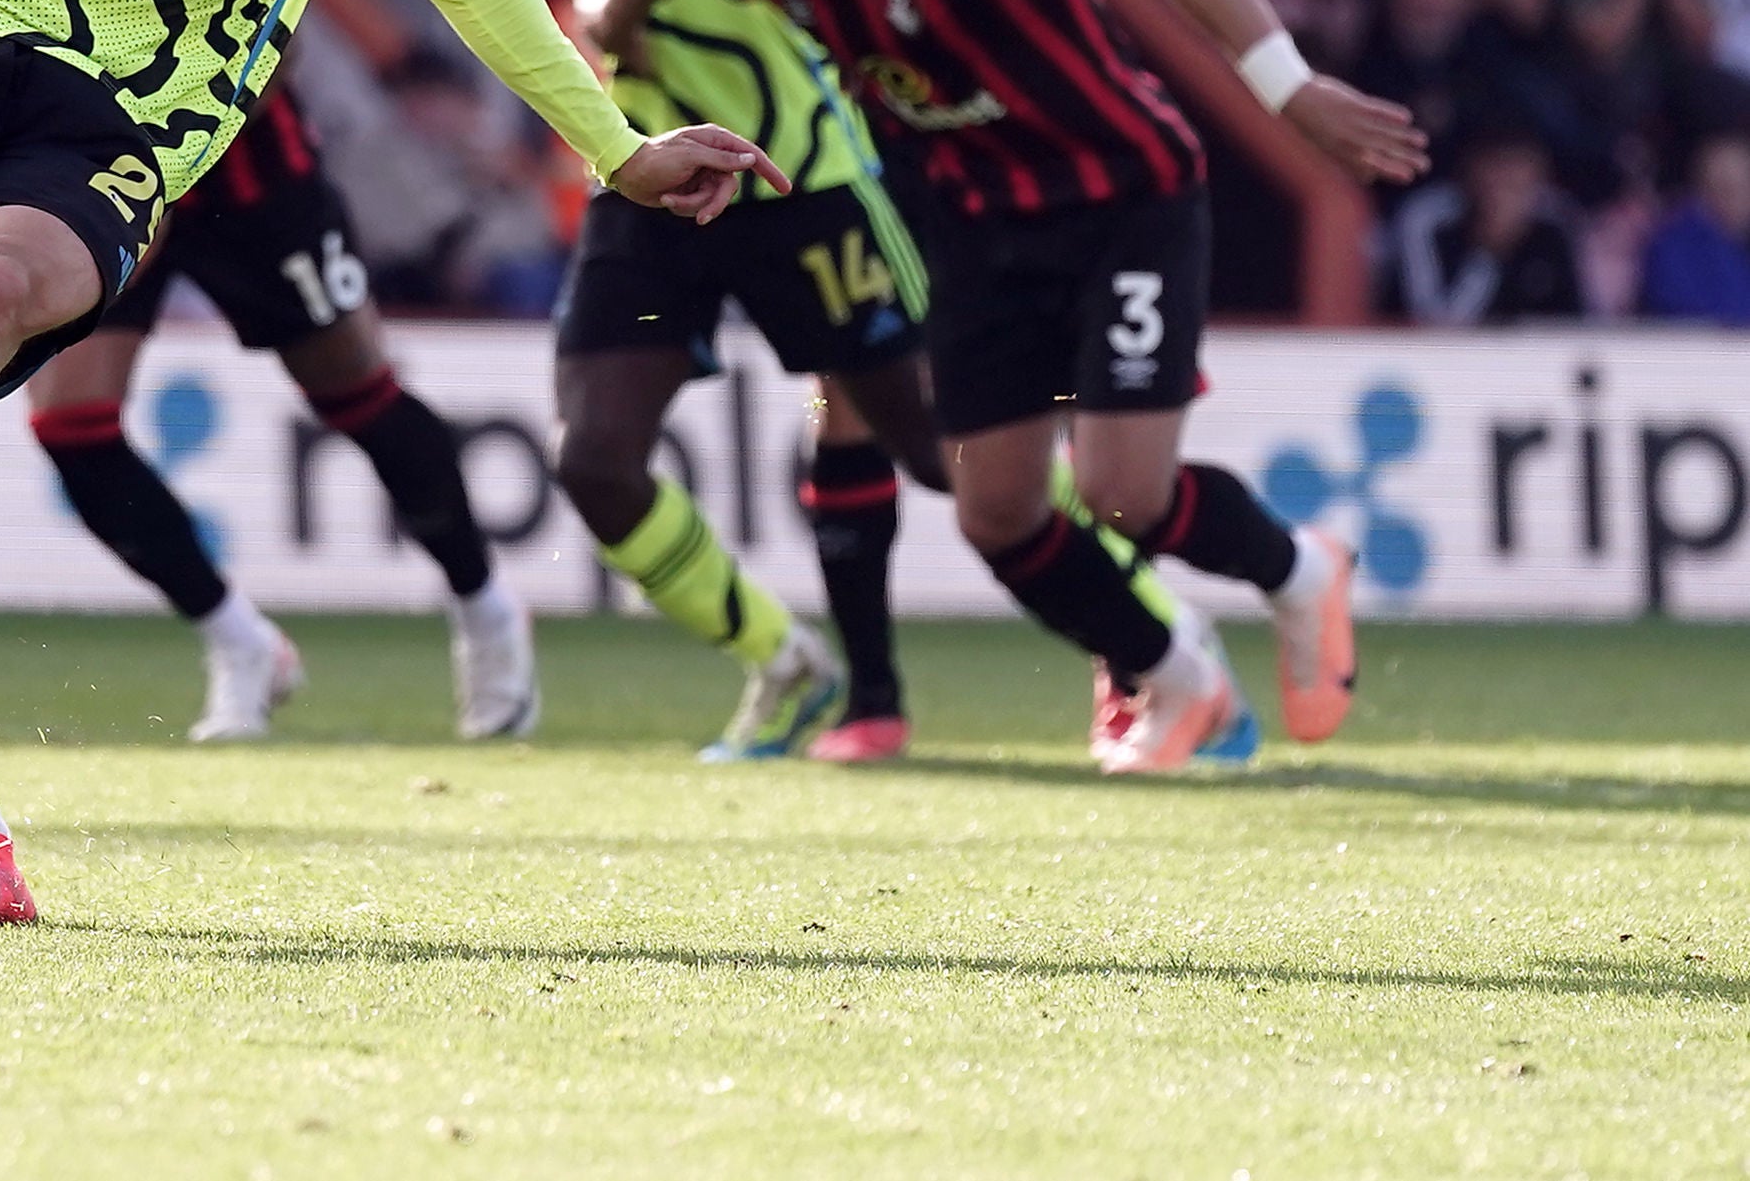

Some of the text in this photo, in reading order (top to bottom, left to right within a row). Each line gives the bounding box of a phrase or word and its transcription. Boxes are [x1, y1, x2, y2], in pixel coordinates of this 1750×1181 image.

[281, 229, 368, 325] 16
[799, 228, 897, 325] 14
[1107, 271, 1164, 357] 3
